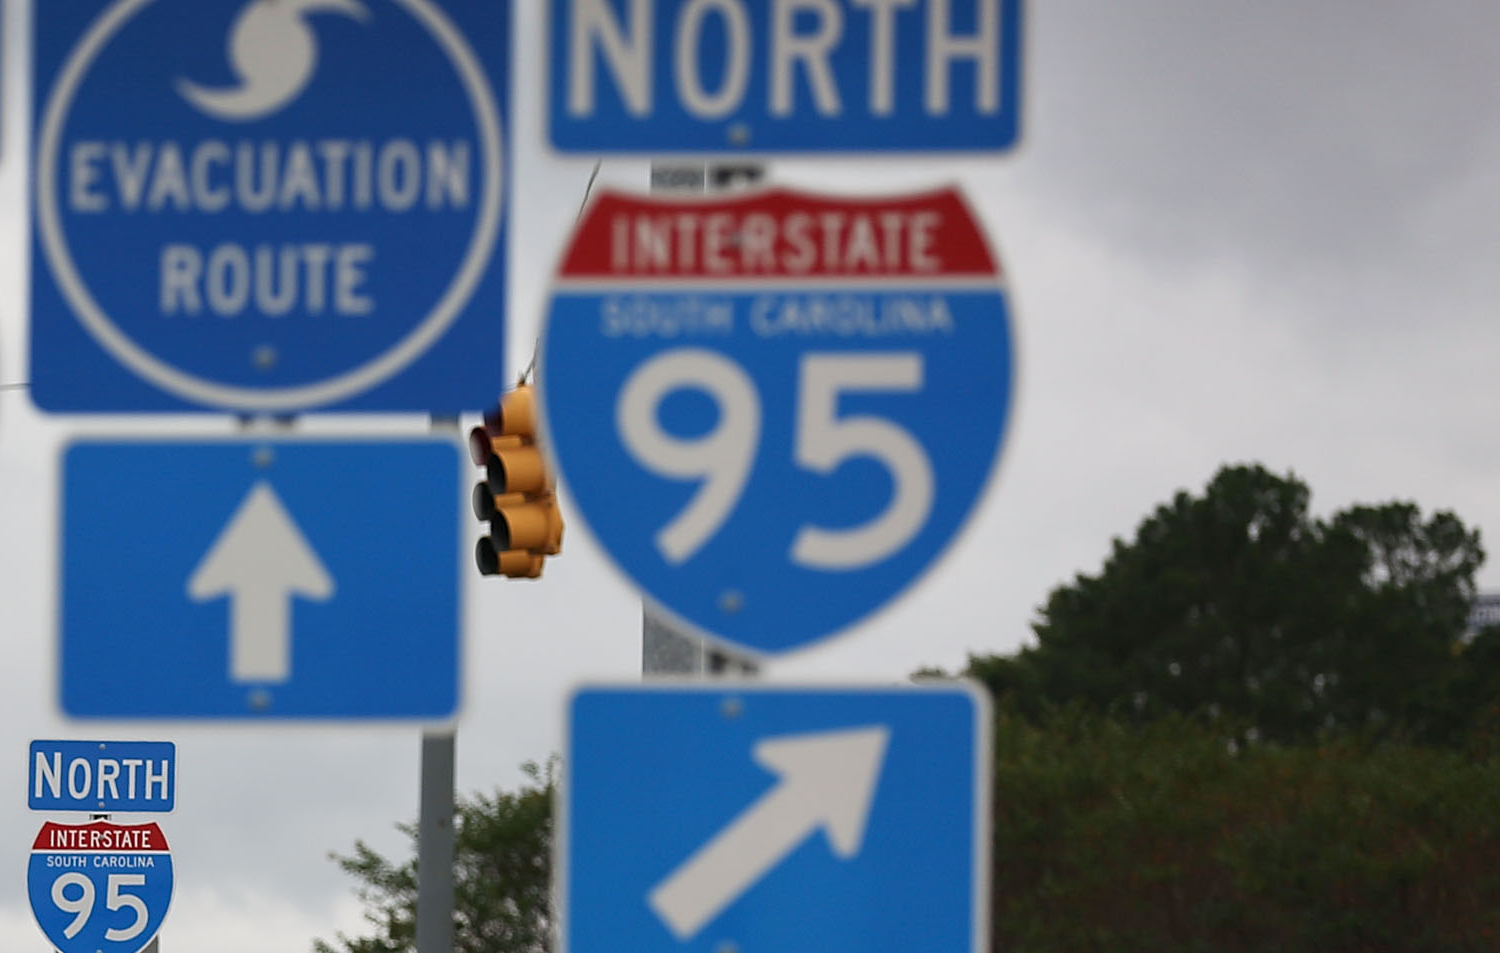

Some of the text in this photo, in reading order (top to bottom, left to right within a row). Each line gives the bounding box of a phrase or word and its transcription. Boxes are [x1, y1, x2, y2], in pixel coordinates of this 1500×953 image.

[567, 0, 1000, 119] NORTH
[70, 141, 469, 213] EVACUATION
[611, 213, 942, 274] INTERSTATE
[160, 244, 373, 316] ROUTE
[601, 298, 952, 336] SOUTH CAROLINA
[615, 348, 935, 571] 95
[34, 751, 169, 801] NORTH
[46, 855, 155, 869] SOUTH CAROLINA
[50, 829, 152, 849] INTERSTATE
[51, 872, 149, 942] 95
